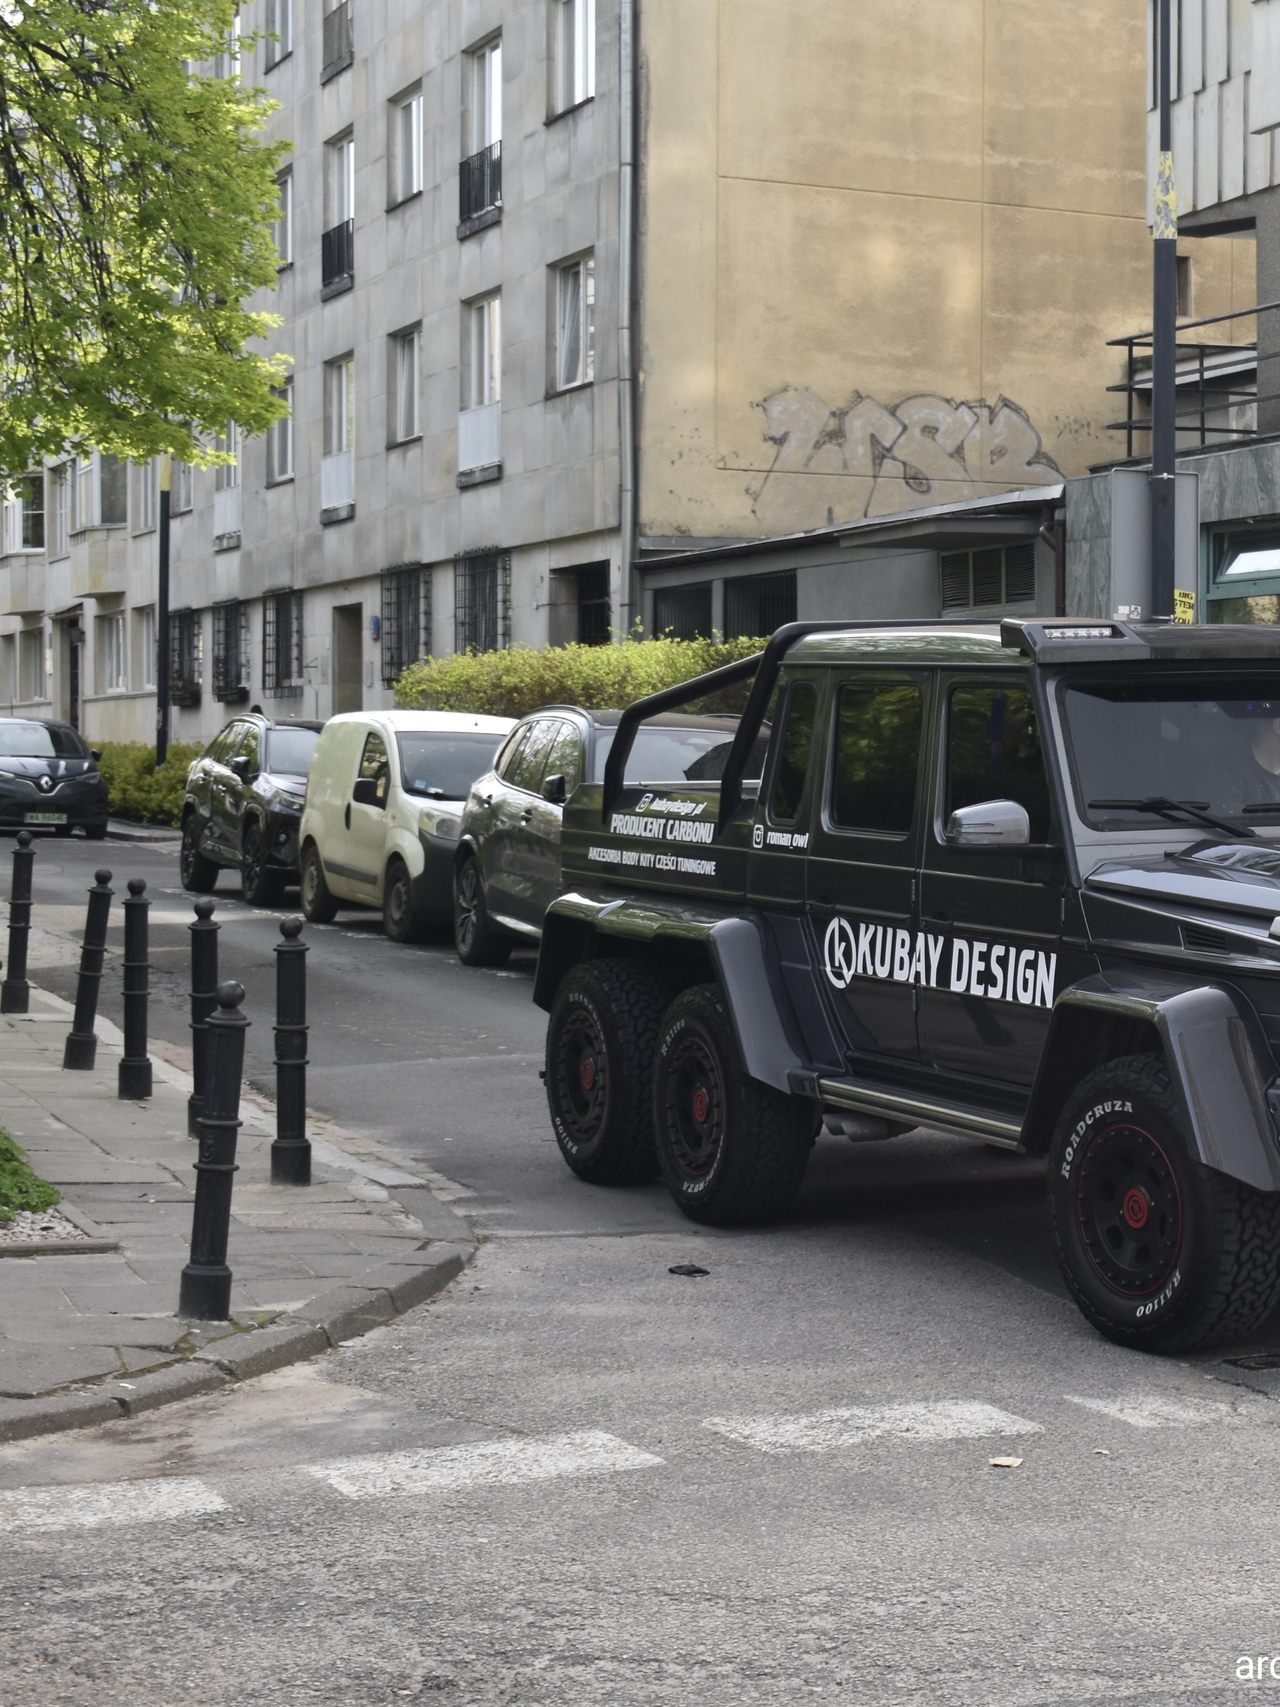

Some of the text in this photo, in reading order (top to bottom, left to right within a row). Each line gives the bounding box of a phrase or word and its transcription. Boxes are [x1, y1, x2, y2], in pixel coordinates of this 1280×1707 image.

[610, 813, 715, 844] PRODUCENT CARBONU
[766, 831, 809, 849] roman_owl
[622, 851, 640, 866] BODY
[677, 858, 716, 876] TUNINGOWE
[856, 922, 1057, 1009] KUBAY DESIGN
[1061, 1100, 1133, 1179] ROADCRUZA
[1136, 1269, 1181, 1318] RA1100
